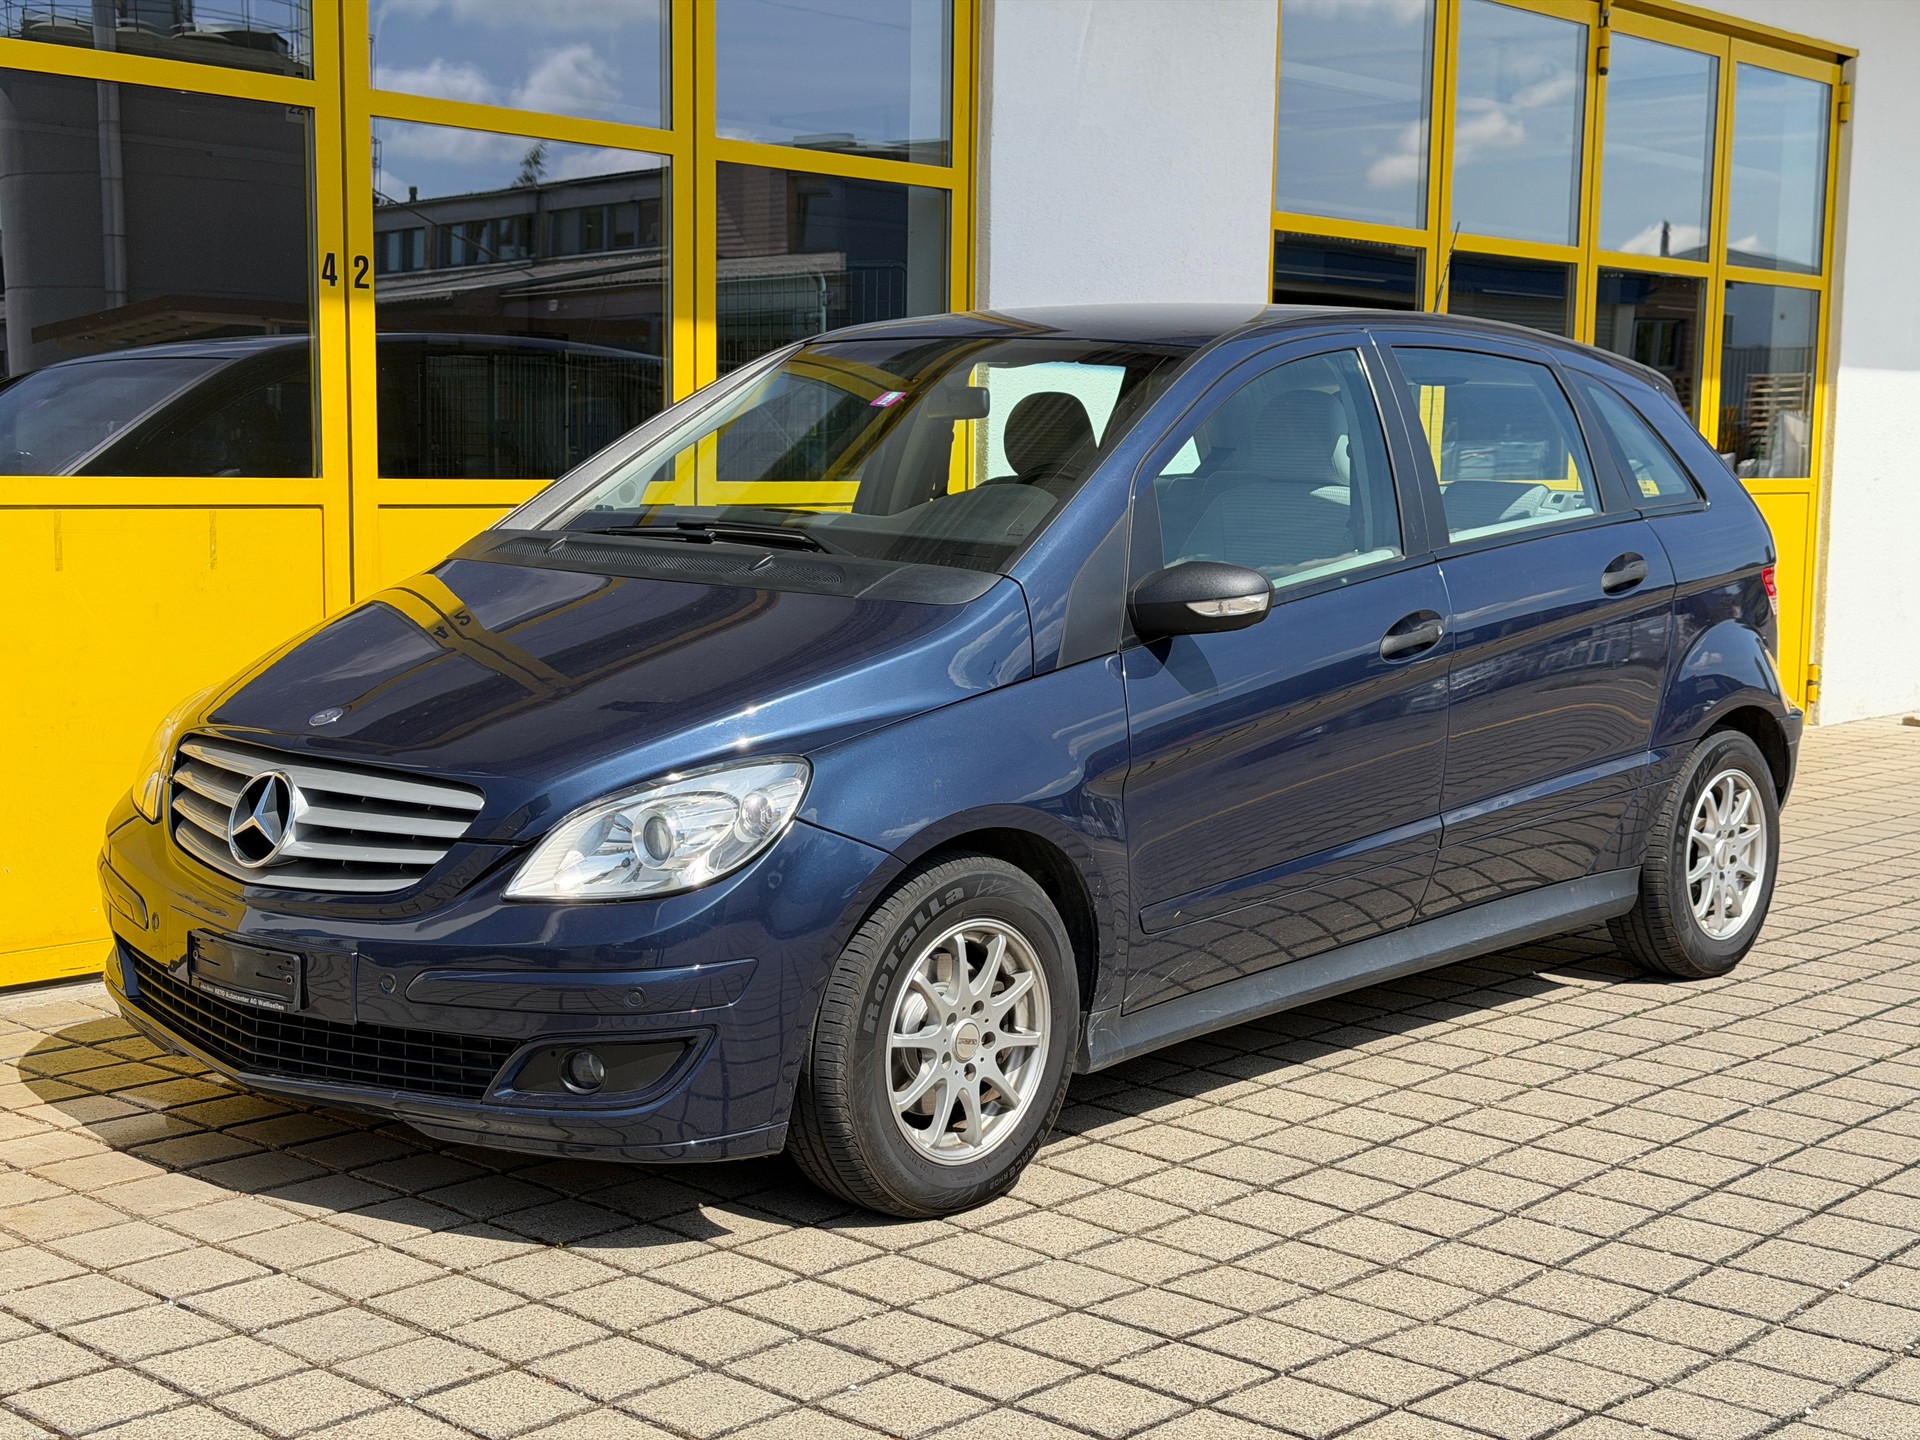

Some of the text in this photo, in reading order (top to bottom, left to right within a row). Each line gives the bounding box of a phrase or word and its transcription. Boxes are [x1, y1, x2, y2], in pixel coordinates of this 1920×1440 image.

[322, 252, 370, 289] 4 2
[249, 997, 257, 1005] AG
[1009, 1128, 1046, 1178] E-RACE
